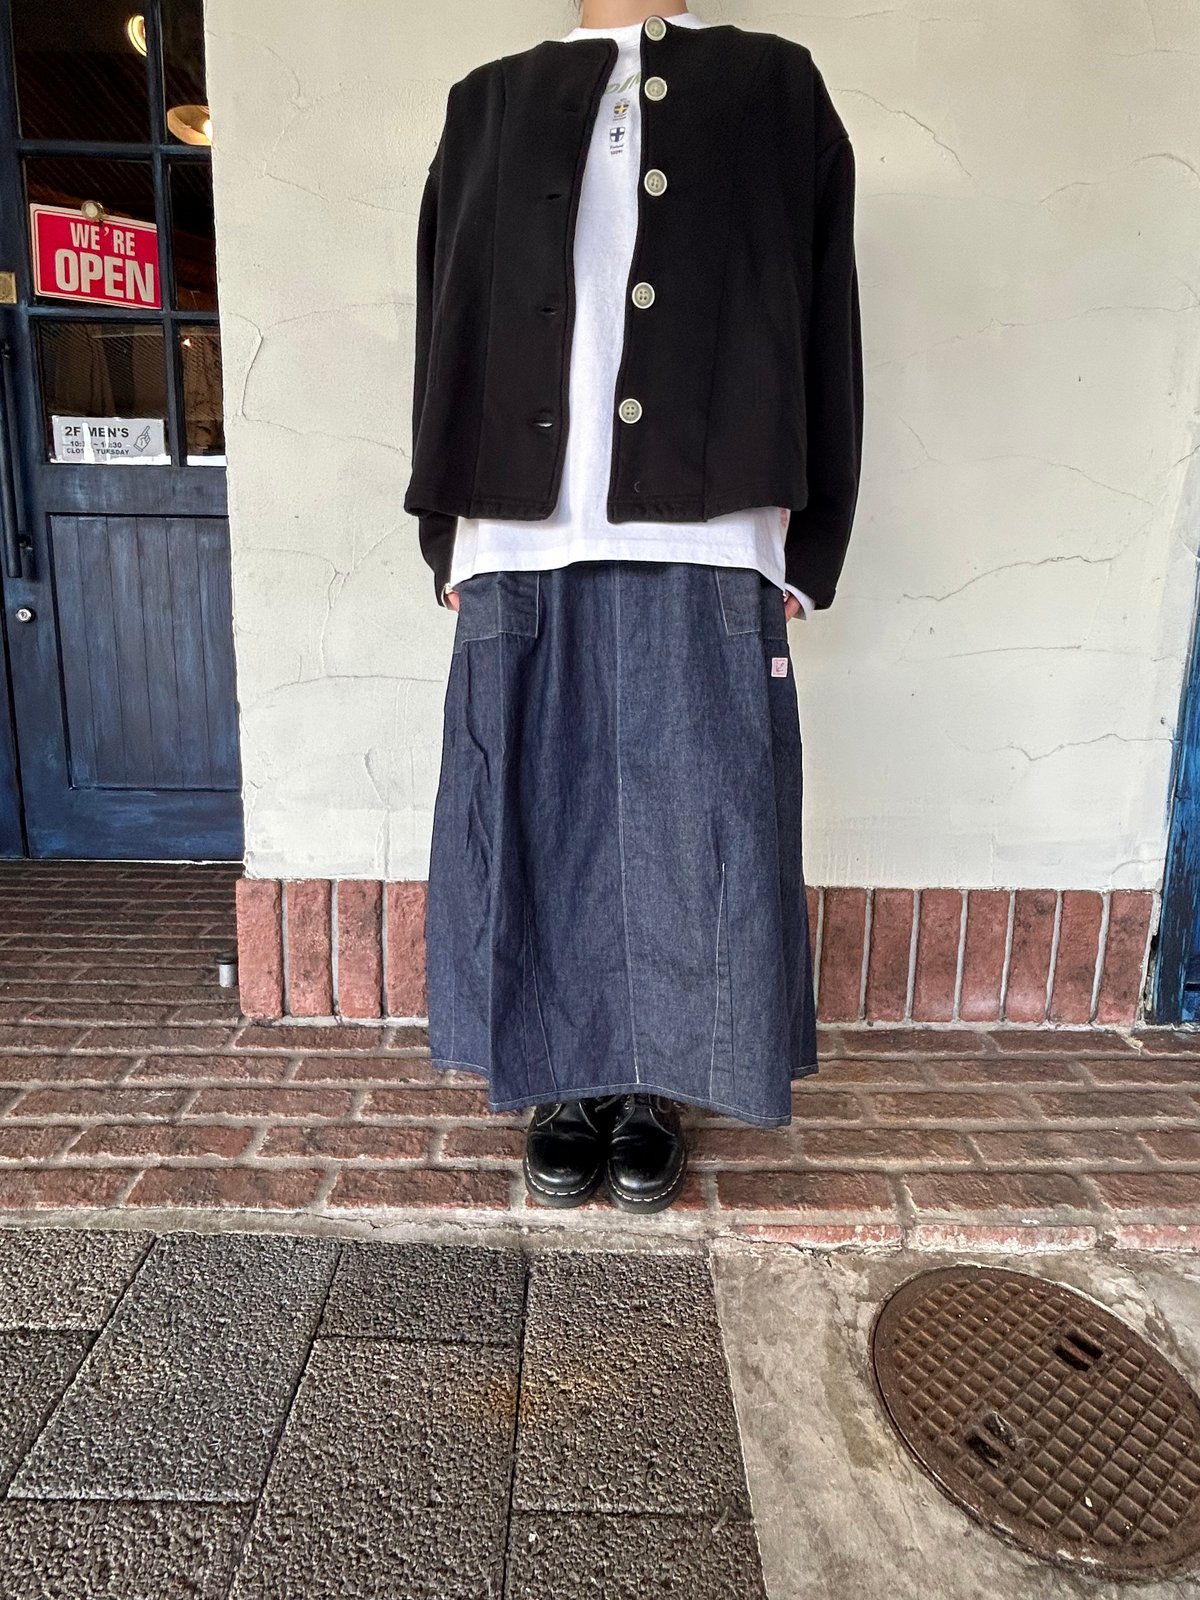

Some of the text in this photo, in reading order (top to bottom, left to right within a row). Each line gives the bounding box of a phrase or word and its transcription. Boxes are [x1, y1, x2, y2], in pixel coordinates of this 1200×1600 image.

[69, 222, 136, 256] WE'RE
[54, 248, 155, 303] OPEN
[65, 426, 129, 438] 2F MEN'S
